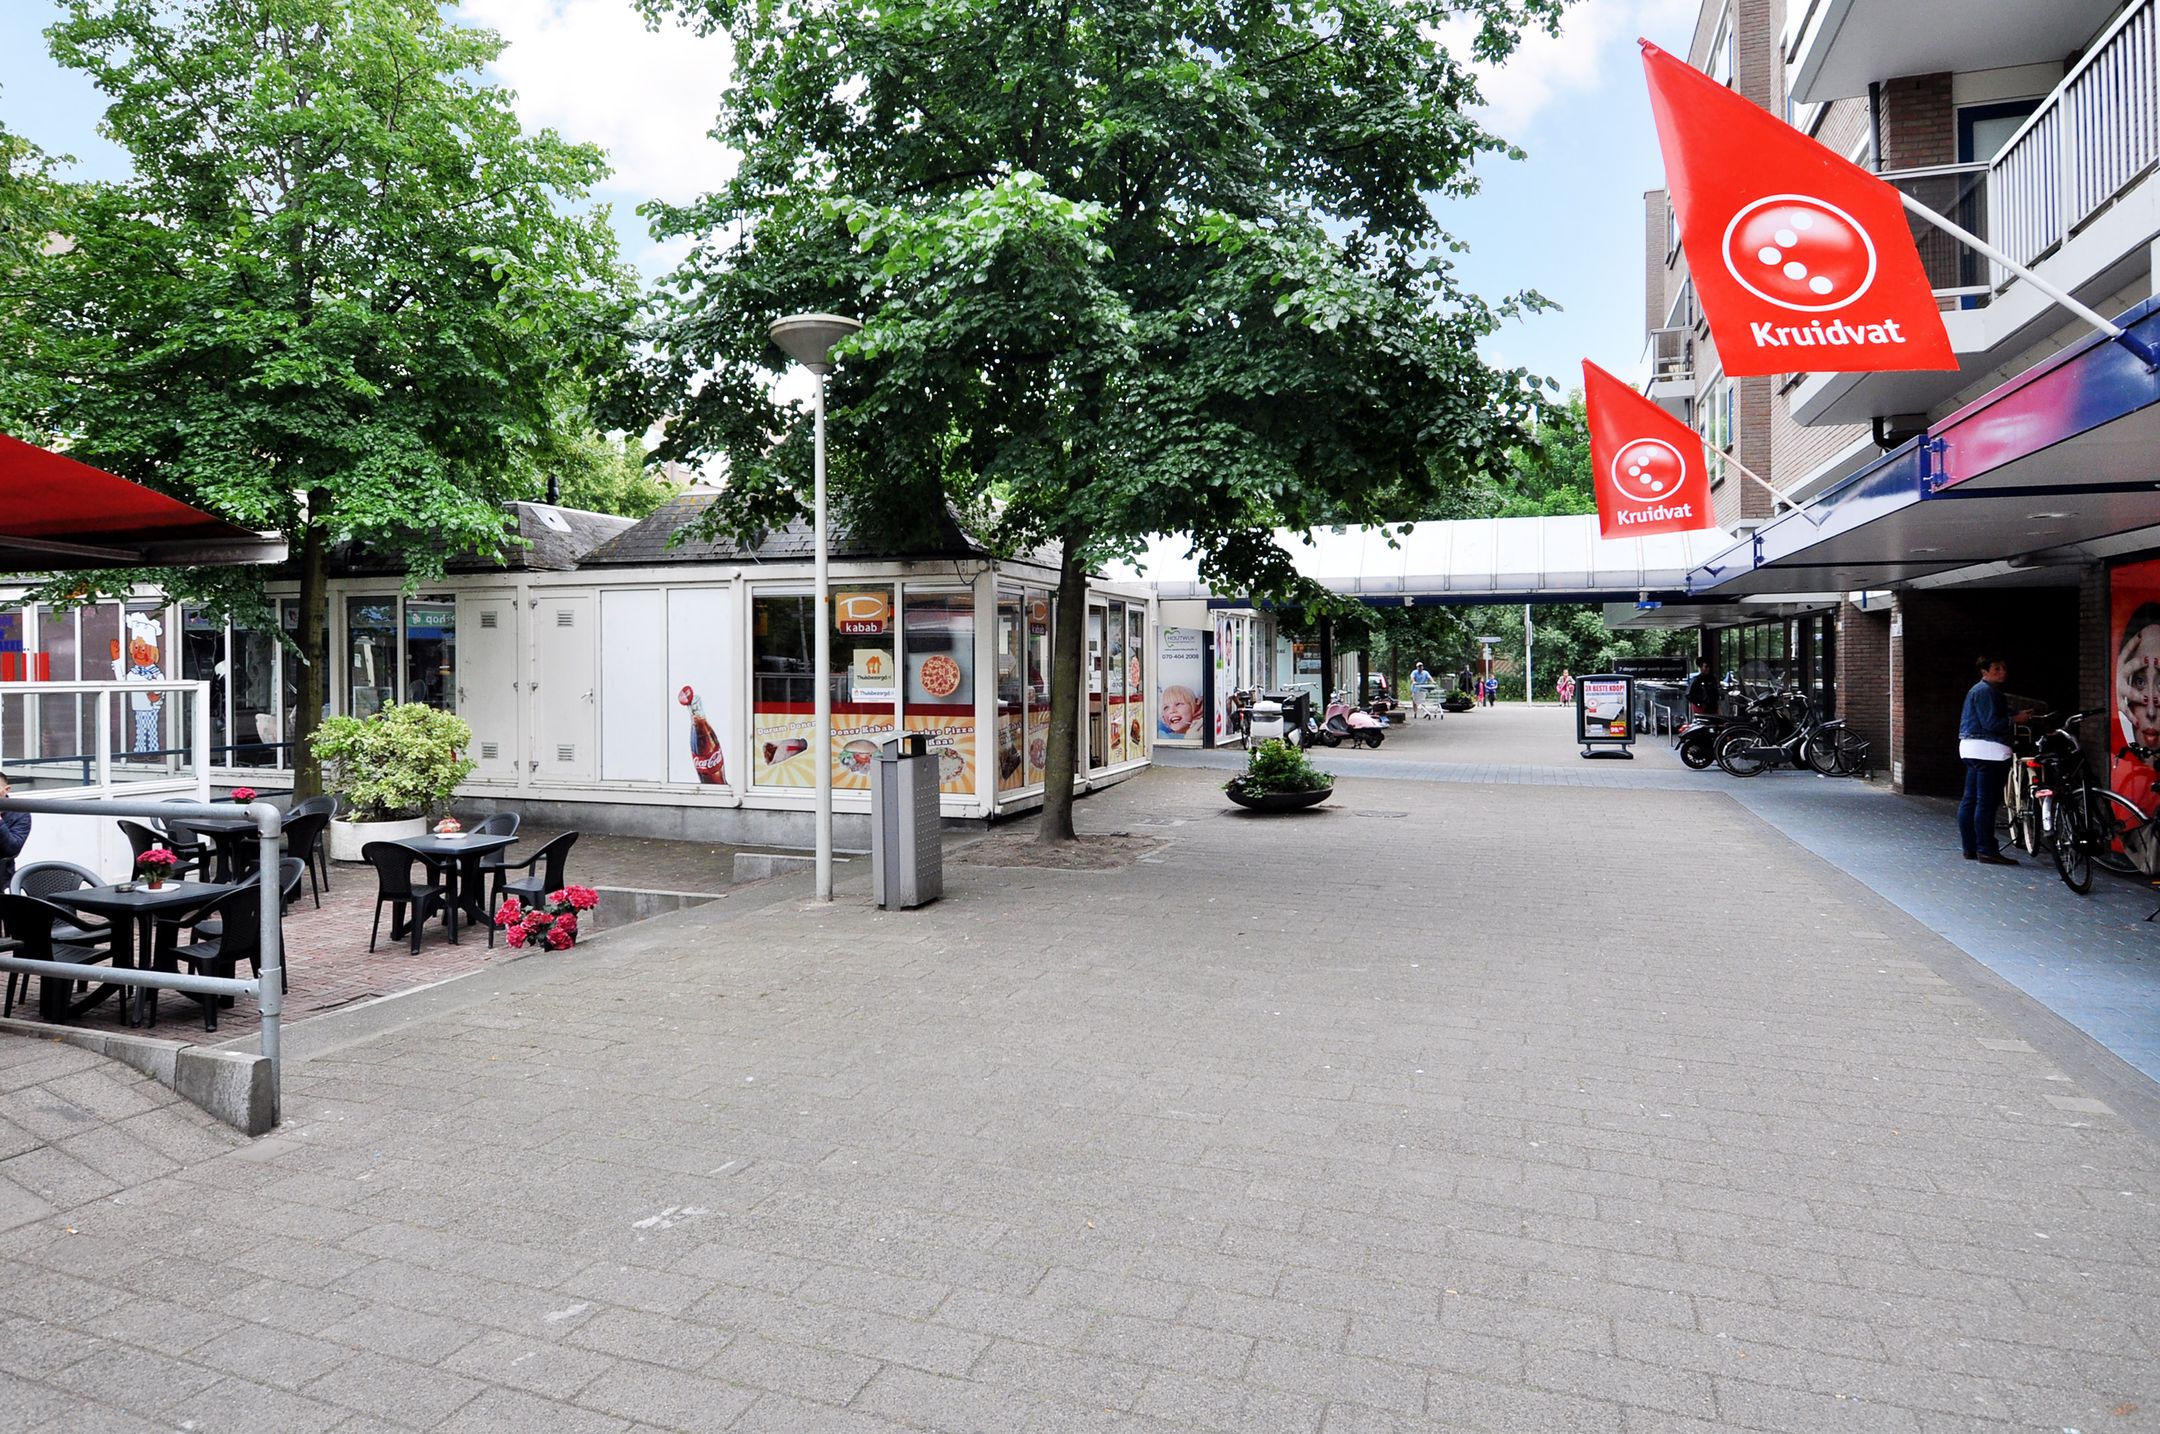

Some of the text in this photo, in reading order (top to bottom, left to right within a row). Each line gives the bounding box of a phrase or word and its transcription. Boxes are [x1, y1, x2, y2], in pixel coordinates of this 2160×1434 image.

[1750, 319, 1906, 348] Kruidvat
[1617, 503, 1692, 525] Kruidvat
[845, 622, 878, 632] kabab
[861, 724, 894, 734] Kabab
[943, 726, 975, 736] Pizza
[927, 738, 955, 746] Kaas
